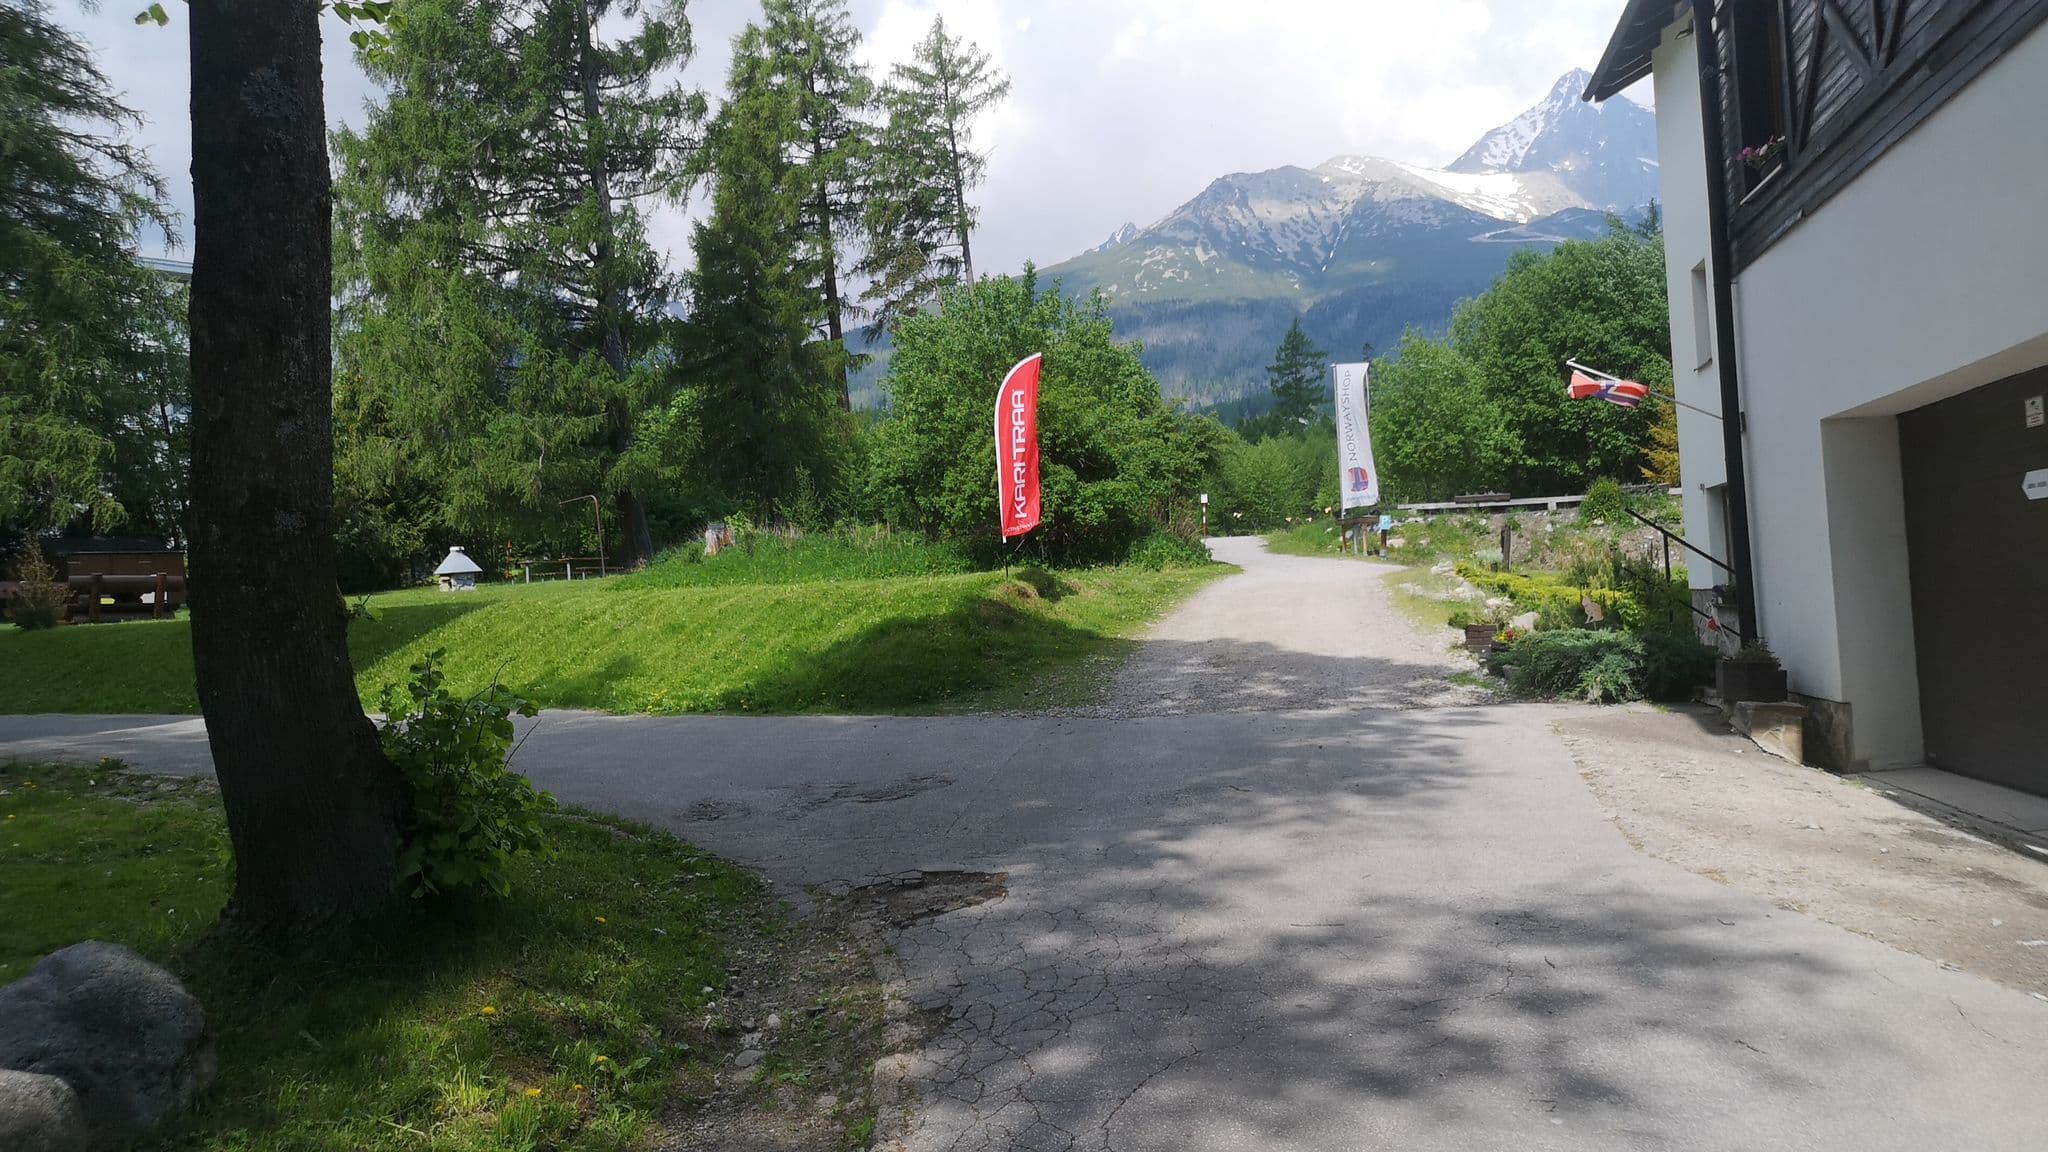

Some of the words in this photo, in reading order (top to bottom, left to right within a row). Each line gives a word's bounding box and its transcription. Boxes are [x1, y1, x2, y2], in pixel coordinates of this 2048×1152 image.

[1012, 390, 1025, 460] TRAA
[1342, 370, 1357, 462] NORWAYSHOP
[1014, 462, 1027, 519] KARI
